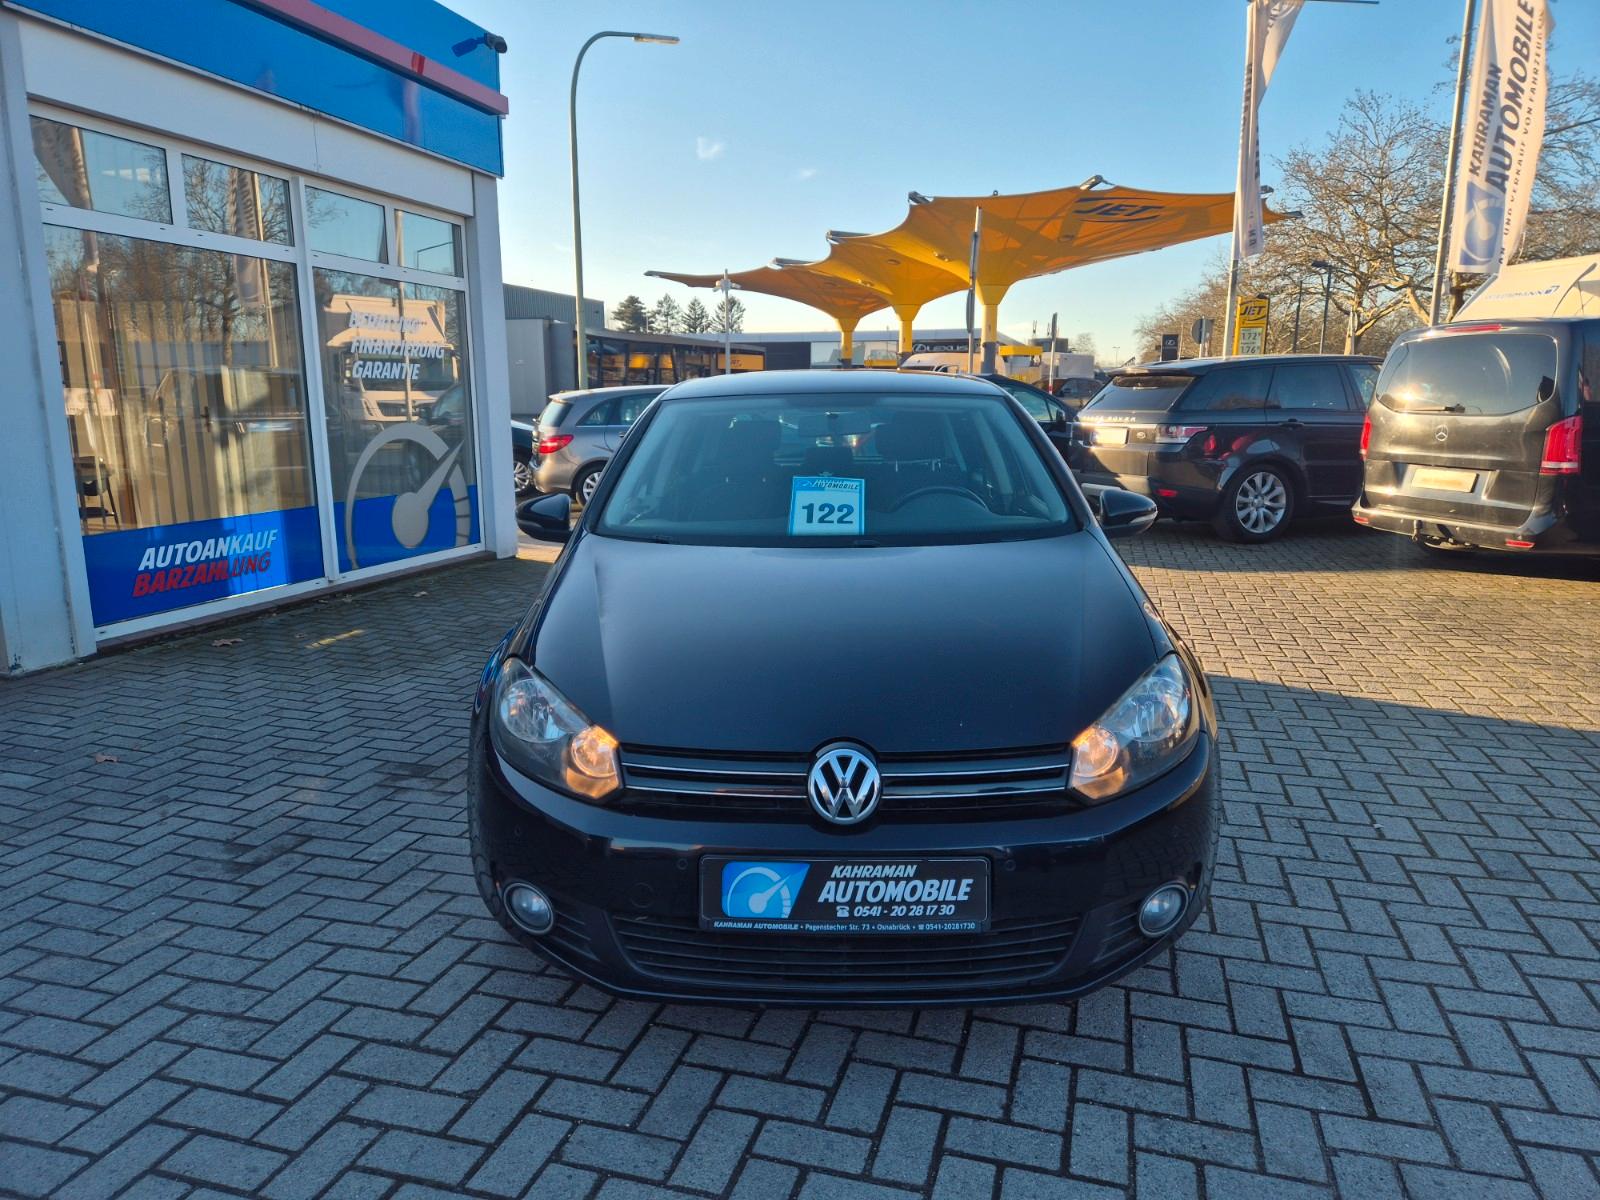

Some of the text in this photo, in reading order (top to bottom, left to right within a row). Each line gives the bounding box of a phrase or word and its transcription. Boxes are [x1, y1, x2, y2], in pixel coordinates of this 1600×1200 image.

[1485, 0, 1535, 194] AUTOMOBILE
[1468, 62, 1503, 177] KAHRAMAN
[1523, 106, 1533, 135] VON
[1073, 202, 1166, 217] JET
[1240, 305, 1266, 316] JET
[351, 337, 445, 359] FINANZIERUNG
[926, 344, 969, 353] LEXUS
[352, 361, 420, 380] GARANTIE
[801, 502, 855, 525] 122
[138, 529, 278, 571] AUTOANKAUF
[132, 551, 272, 597] BARZAHLUNG
[831, 864, 918, 879] KAHRAMAN
[817, 878, 974, 904] AUTOMOBILE
[853, 906, 881, 918] 0541
[891, 905, 907, 917] 20
[909, 904, 923, 917] 28
[925, 904, 937, 916] 17
[939, 903, 956, 916] 30
[713, 921, 753, 929] KAHRAMAN
[753, 922, 799, 931] AUTOMOBILE
[848, 923, 860, 931] Str.
